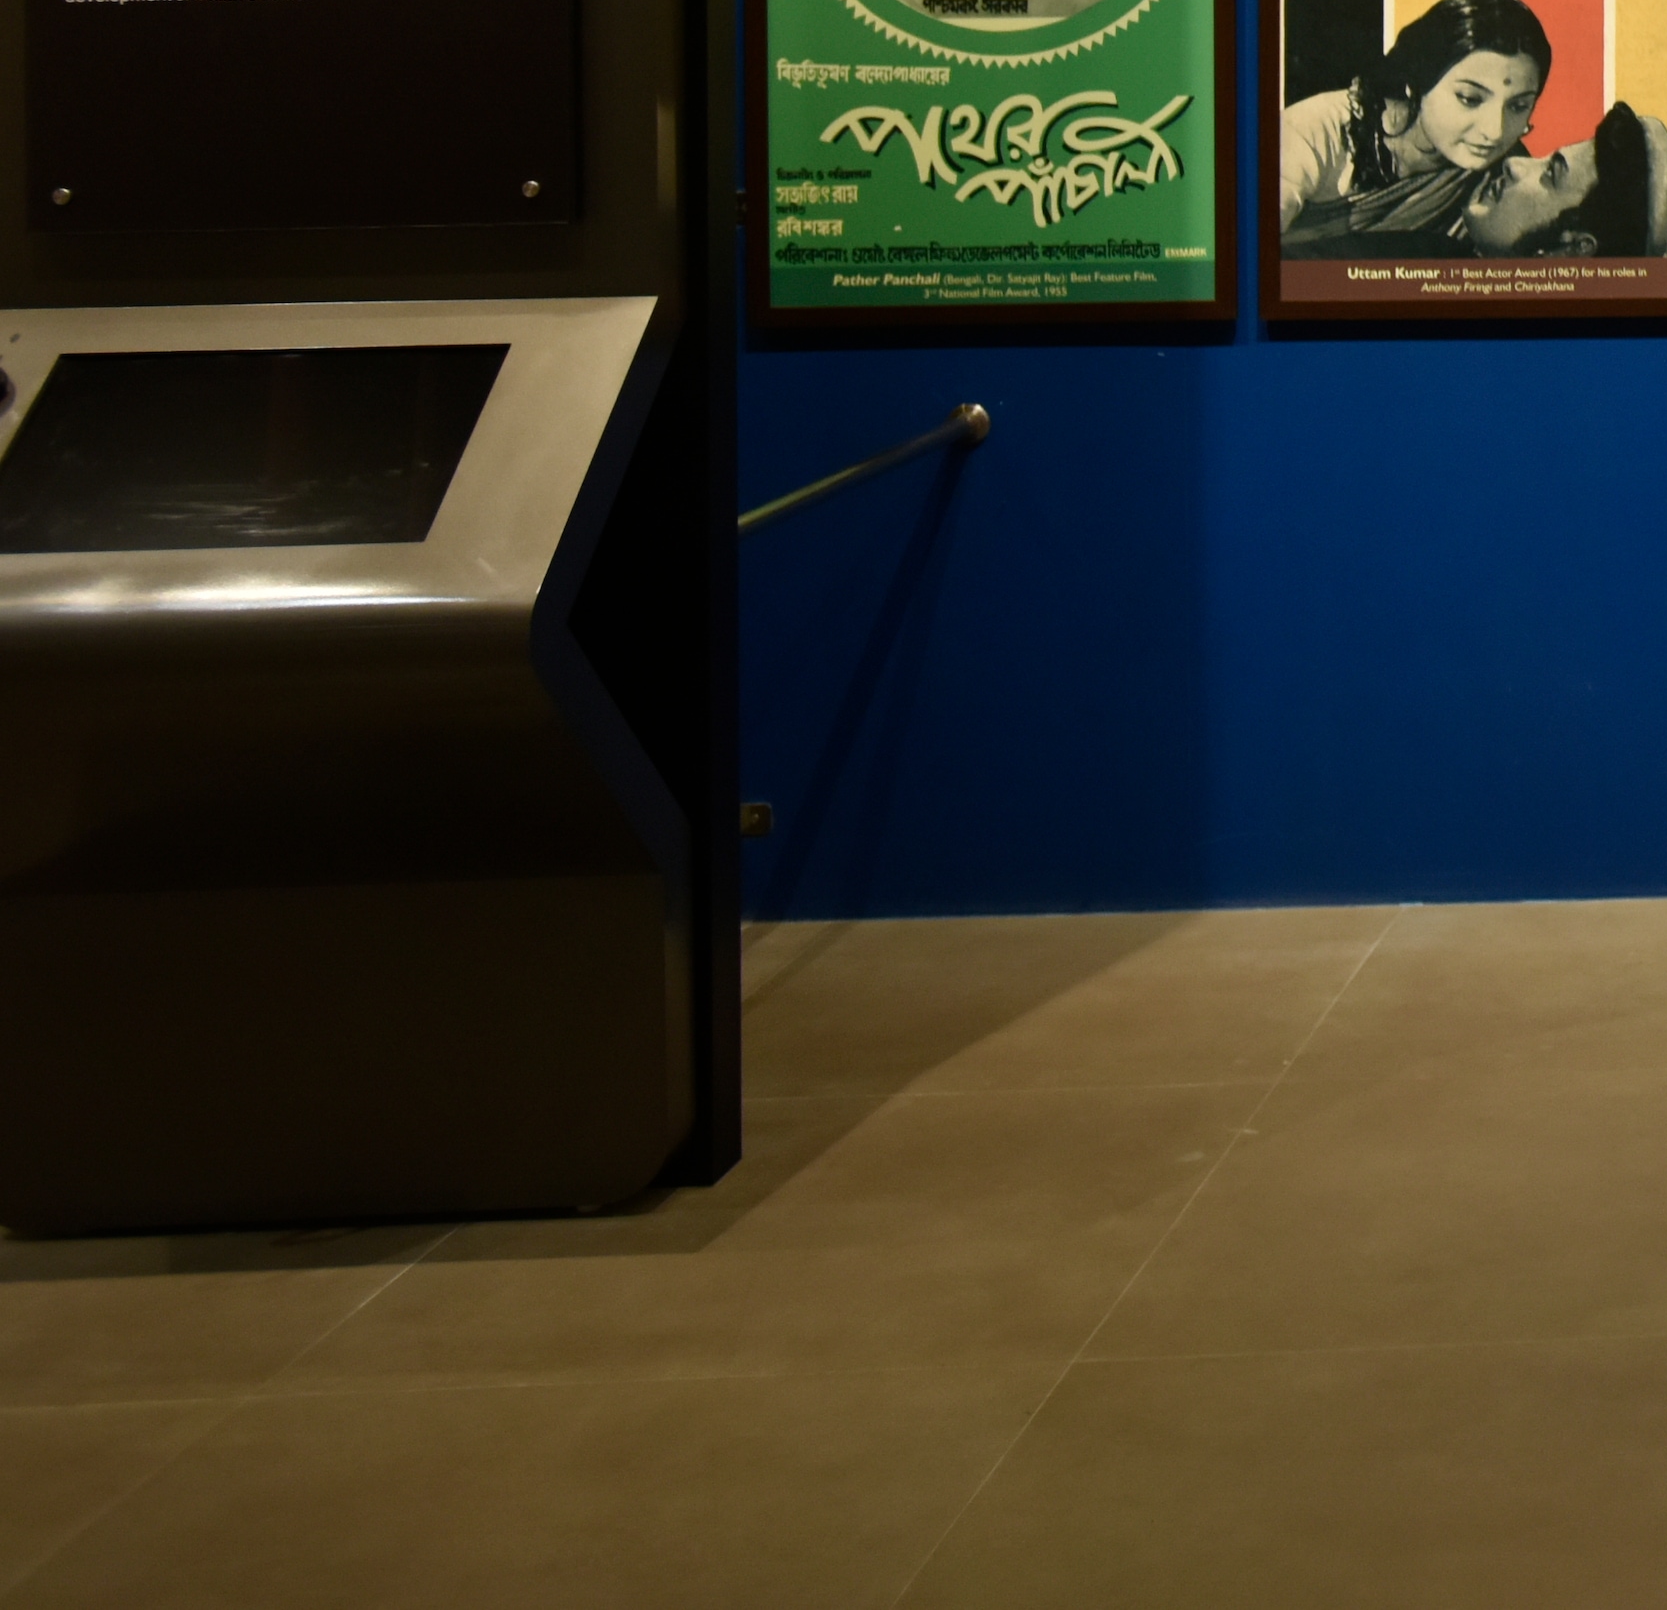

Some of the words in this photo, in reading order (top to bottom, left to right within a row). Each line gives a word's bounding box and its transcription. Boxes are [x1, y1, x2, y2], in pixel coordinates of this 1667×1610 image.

[833, 274, 880, 287] Pather
[883, 272, 941, 286] Panchali
[1347, 267, 1392, 280] Uttam
[1394, 266, 1441, 280] Kumar
[1462, 268, 1483, 279] Best
[1485, 268, 1512, 279] Actor
[1514, 267, 1547, 278] Award
[1548, 267, 1579, 279] (1967)
[1581, 267, 1595, 278] for
[1597, 267, 1611, 277] his
[1612, 267, 1636, 277] roles
[1637, 268, 1647, 277] in
